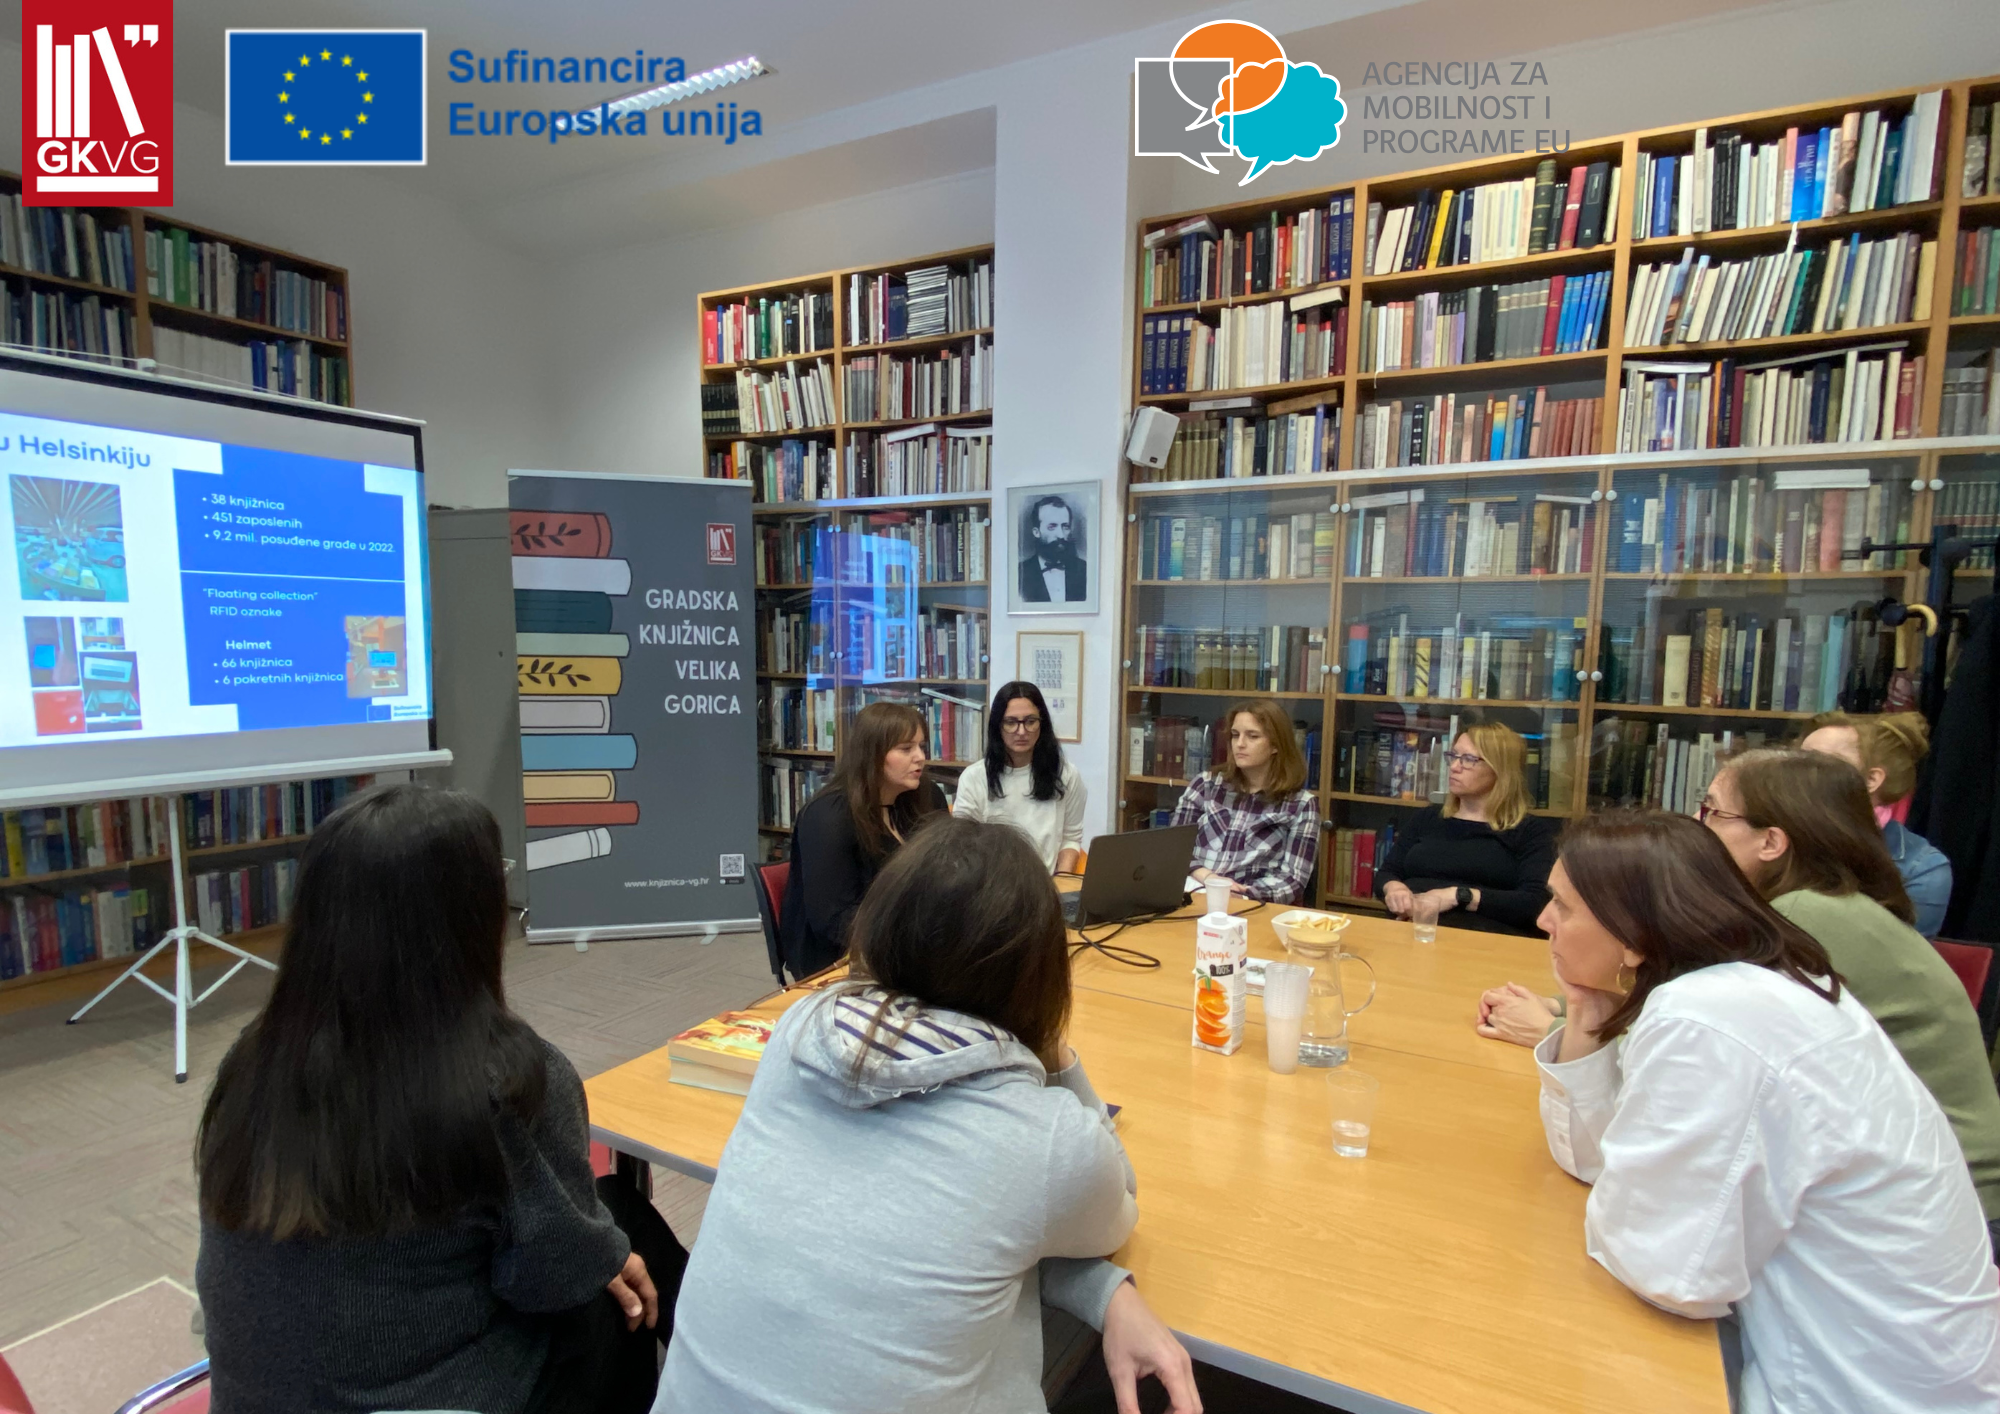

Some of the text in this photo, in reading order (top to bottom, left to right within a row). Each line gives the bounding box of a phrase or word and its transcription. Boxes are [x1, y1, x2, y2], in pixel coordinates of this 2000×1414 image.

[19, 434, 151, 470] Helsinkiju
[210, 493, 285, 511] 38 knjižnica
[211, 512, 303, 529] 451 zaposlenih
[235, 531, 258, 543] mil.
[260, 533, 321, 547] posuđene
[322, 539, 357, 550] građe
[368, 541, 396, 553] 2022.
[645, 588, 740, 612] GRADSKA
[209, 606, 283, 617] RFID oznake
[639, 619, 741, 646] KNJIŽNICA
[225, 639, 272, 650] Helmet
[221, 657, 293, 670] 66 knjižnica
[674, 659, 741, 681] VELIKA
[222, 672, 344, 687] 6 pokretnih knjižnica
[664, 694, 742, 715] GORICA
